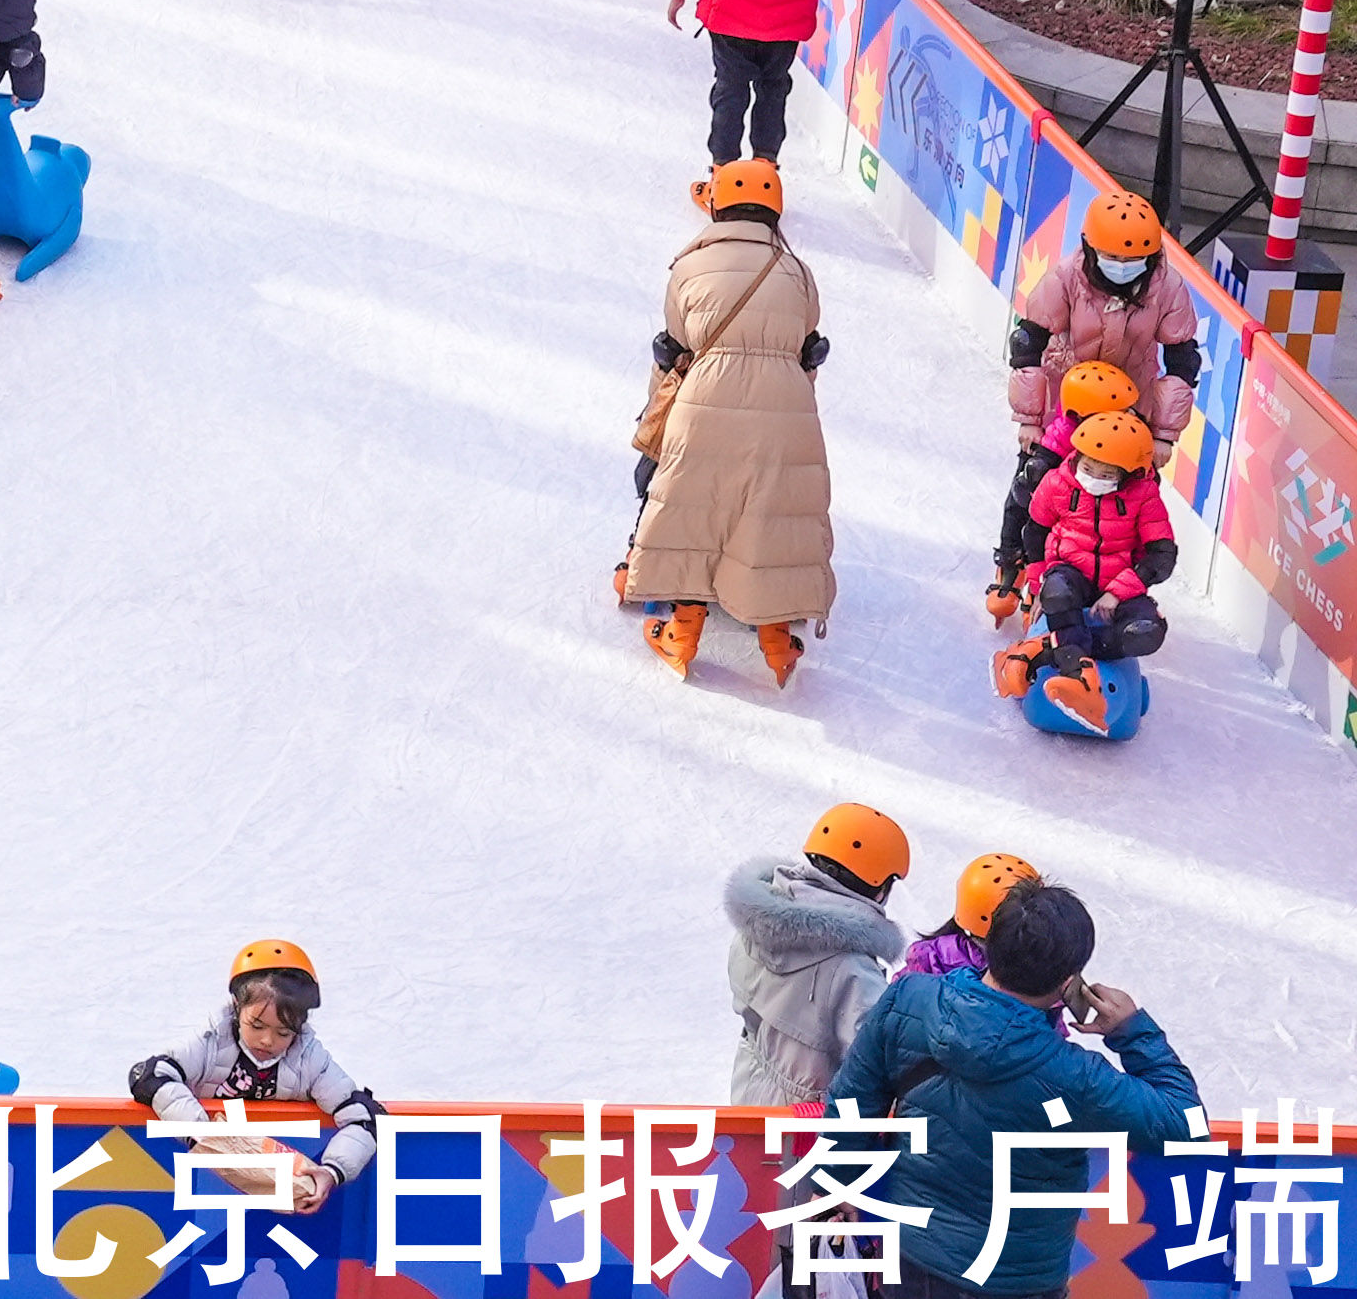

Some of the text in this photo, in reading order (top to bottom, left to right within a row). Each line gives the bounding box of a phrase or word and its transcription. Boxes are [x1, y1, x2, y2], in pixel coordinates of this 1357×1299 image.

[1280, 447, 1355, 567] 冬梦
[1267, 536, 1344, 633] ICE CHESS
